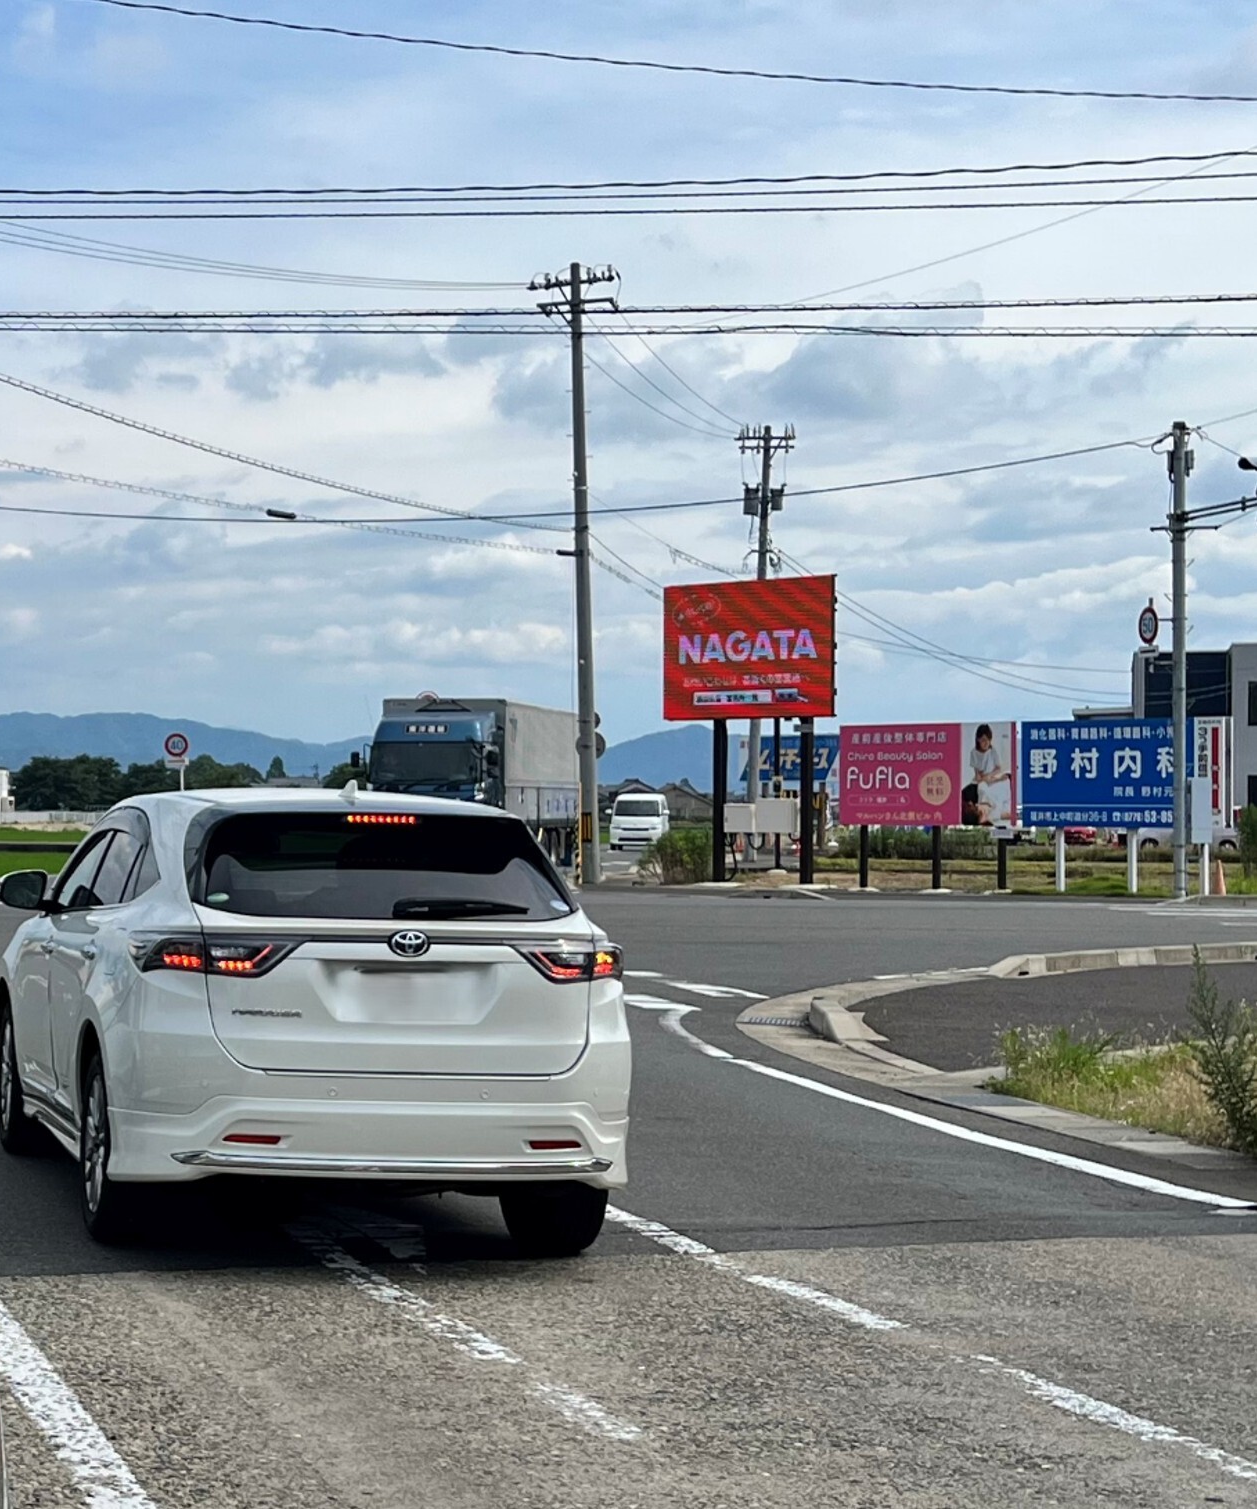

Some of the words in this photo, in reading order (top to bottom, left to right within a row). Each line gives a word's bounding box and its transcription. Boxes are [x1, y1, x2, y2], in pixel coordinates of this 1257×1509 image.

[1142, 616, 1154, 635] 50
[678, 629, 817, 664] NAGATA
[170, 739, 183, 750] 40
[847, 752, 874, 761] Chiro
[877, 752, 914, 763] Beauty
[916, 750, 944, 760] Salon
[1029, 747, 1174, 779] 野村内科
[847, 766, 910, 790] fufla
